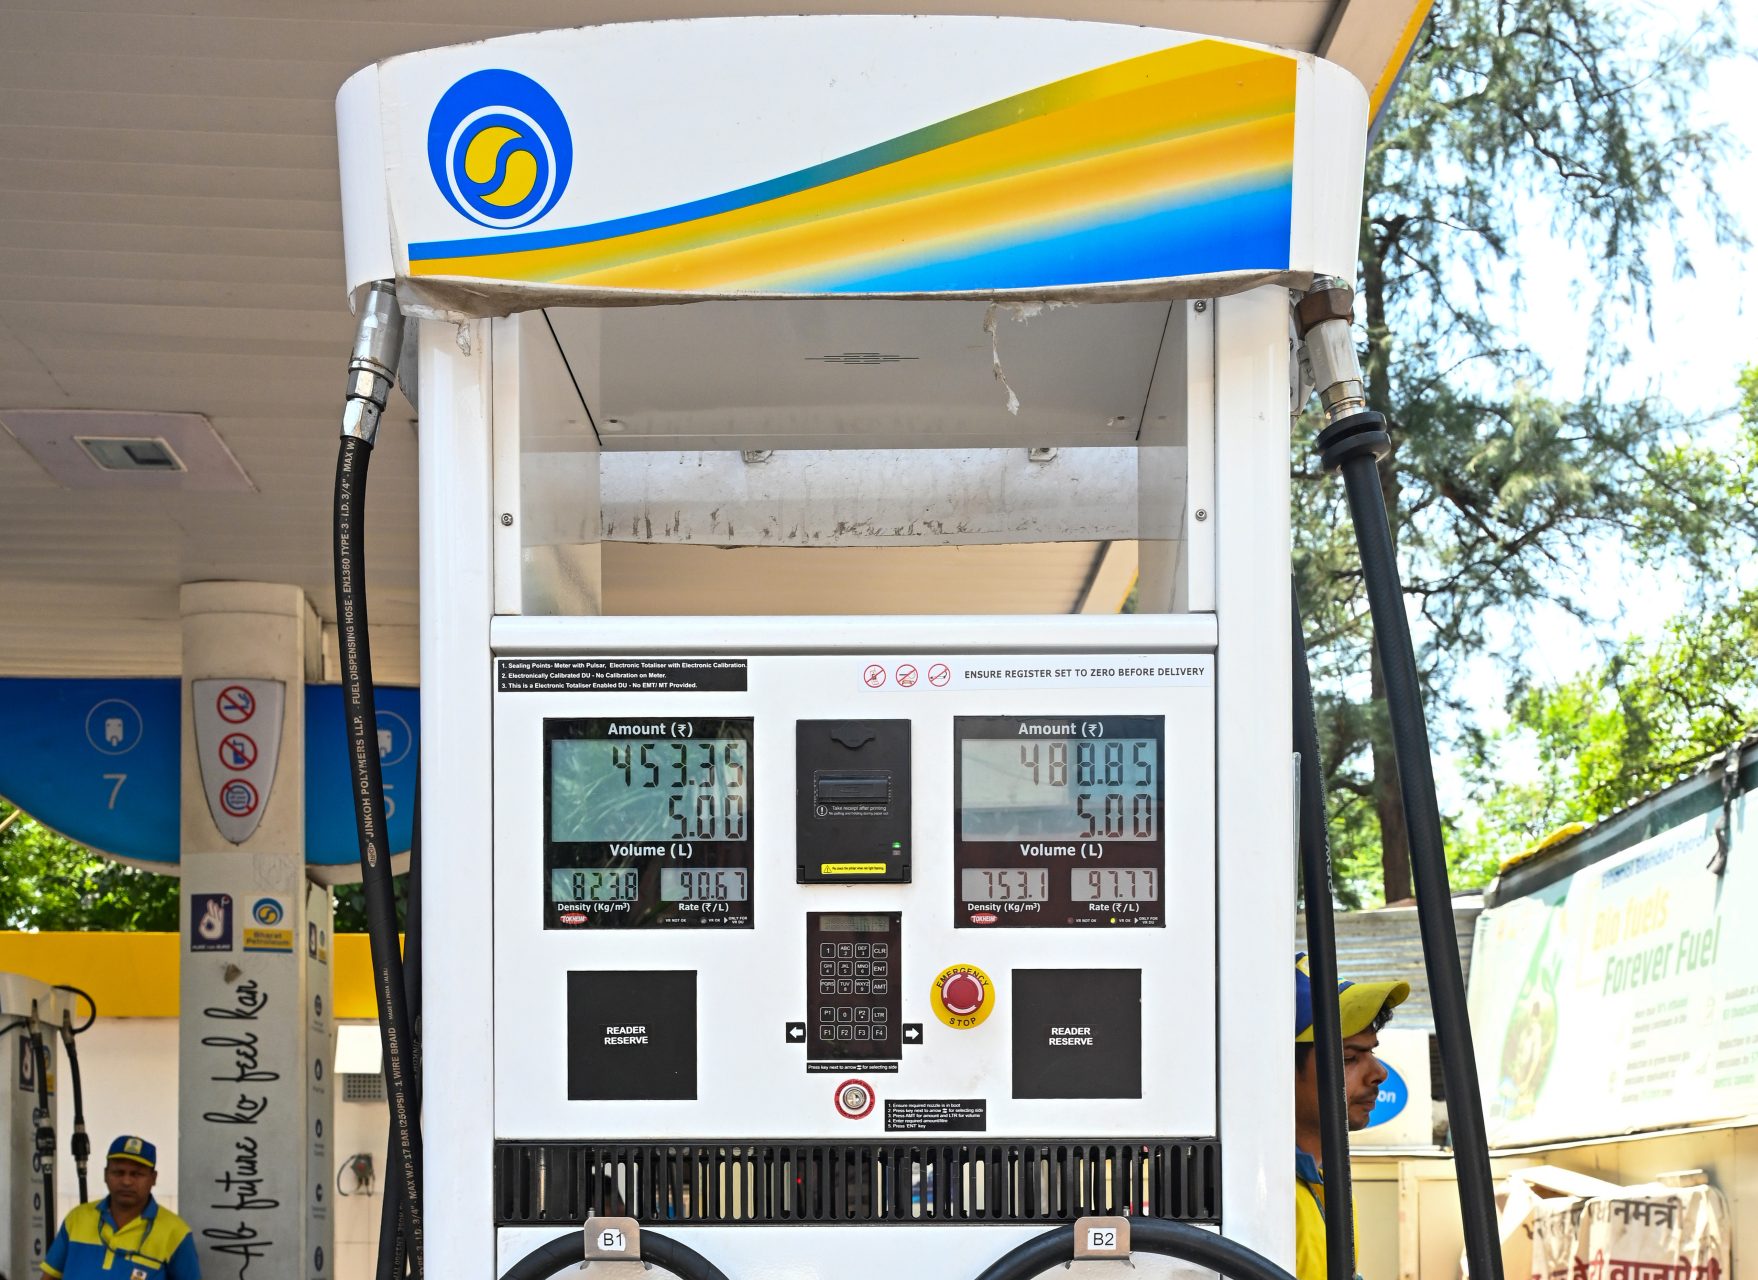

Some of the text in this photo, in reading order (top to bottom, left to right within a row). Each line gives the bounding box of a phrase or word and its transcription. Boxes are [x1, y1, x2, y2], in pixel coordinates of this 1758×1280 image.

[343, 452, 354, 472] MAX
[341, 558, 352, 593] EN1360
[344, 600, 354, 624] HOSE
[346, 625, 359, 680] DISPENSING
[964, 667, 1205, 680] ENSURE REGISTER SET TO ZERO BEFORE DELIVERY
[352, 682, 361, 704] FUEL
[608, 722, 694, 738] Amount (₹)
[1018, 722, 1104, 738] Amount (₹)
[355, 739, 371, 795] POLYMERS
[612, 743, 744, 788] 453.35
[1020, 742, 1151, 787] 488.85
[103, 773, 127, 809] 7
[361, 797, 375, 838] JINKOH
[668, 794, 744, 840] 5.00
[1077, 793, 1151, 838] 5.00
[610, 843, 693, 859] Volume (L)
[1020, 843, 1103, 859] Volume (L)
[572, 871, 637, 901] 823.8
[680, 871, 745, 900] 90.67
[982, 871, 1046, 900] 753.1
[1088, 870, 1154, 899] 97.77
[558, 903, 591, 914] Density
[678, 903, 699, 912] Rate
[968, 903, 1001, 914] Density
[1089, 903, 1109, 912] Rate
[1602, 915, 1722, 998] Forever Fuel
[936, 967, 990, 989] EMERGENCY
[606, 1026, 646, 1035] READER
[949, 1017, 976, 1027] STOP
[1051, 1027, 1091, 1036] READER
[388, 1027, 399, 1055] BRAID
[604, 1036, 648, 1045] RESERVE
[1049, 1037, 1094, 1046] RESERVE
[201, 1032, 279, 1083] feel
[392, 1056, 401, 1080] WIRE
[202, 1094, 268, 1125] ko
[402, 1129, 410, 1148] BAR
[211, 1136, 280, 1211] future
[408, 1179, 418, 1200] MAX
[202, 1222, 273, 1258] Ab
[603, 1232, 623, 1247] B1
[1093, 1232, 1114, 1247] B2
